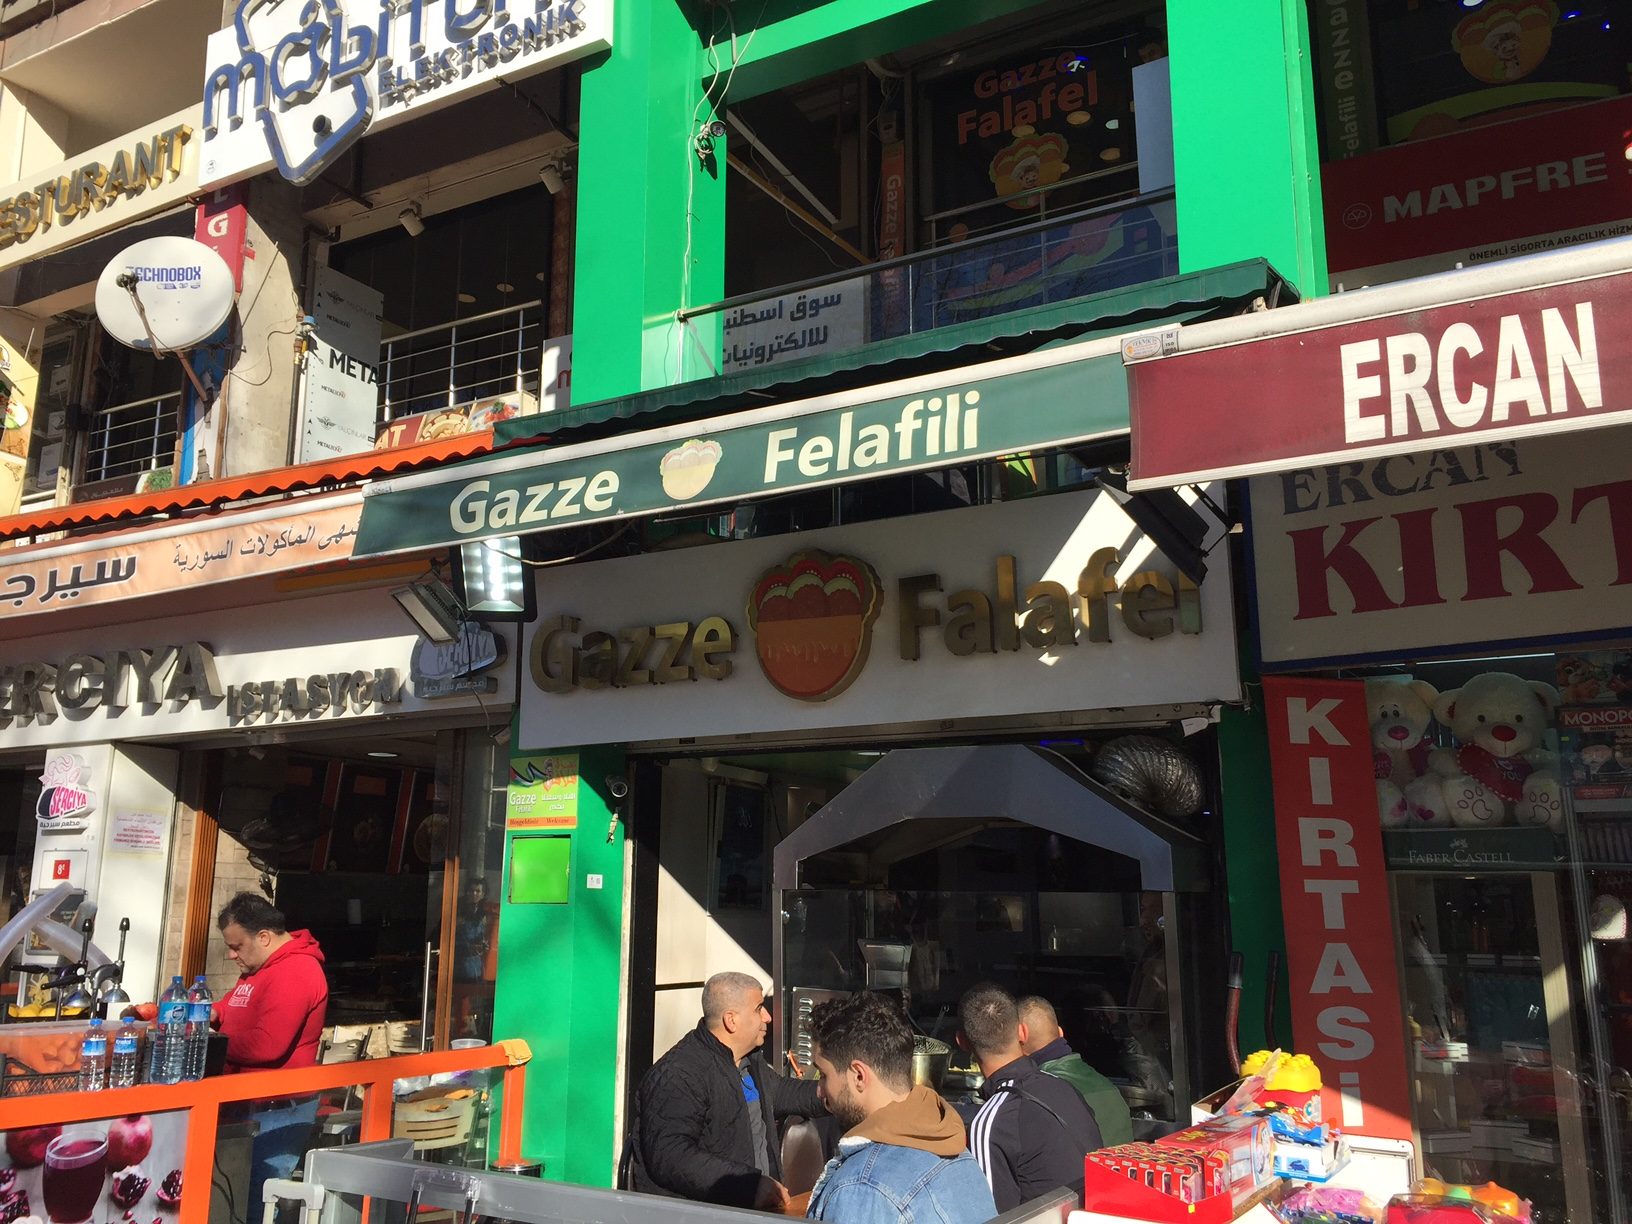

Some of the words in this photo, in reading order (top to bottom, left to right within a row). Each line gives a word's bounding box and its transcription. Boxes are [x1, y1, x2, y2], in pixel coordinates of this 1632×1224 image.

[974, 51, 1077, 99] Gazze
[1326, 0, 1354, 90] azze
[957, 70, 1098, 145] Falafel
[886, 174, 902, 233] Gazze
[1382, 151, 1609, 224] MAPFRE
[1469, 246, 1508, 261] ÖNEMLİ
[1511, 239, 1556, 254] SİGORTA
[1557, 229, 1607, 247] ARACILIK
[789, 293, 842, 322] سوق
[1340, 301, 1603, 443] ERCAN
[449, 470, 621, 535] Gazze
[763, 390, 982, 485] Felafili
[1279, 440, 1523, 516] ERCAN
[173, 538, 233, 573] السورية
[239, 524, 316, 557] المأكولات
[529, 612, 739, 694] Gazze
[898, 546, 1204, 662] Falafel
[510, 792, 537, 806] Gazze
